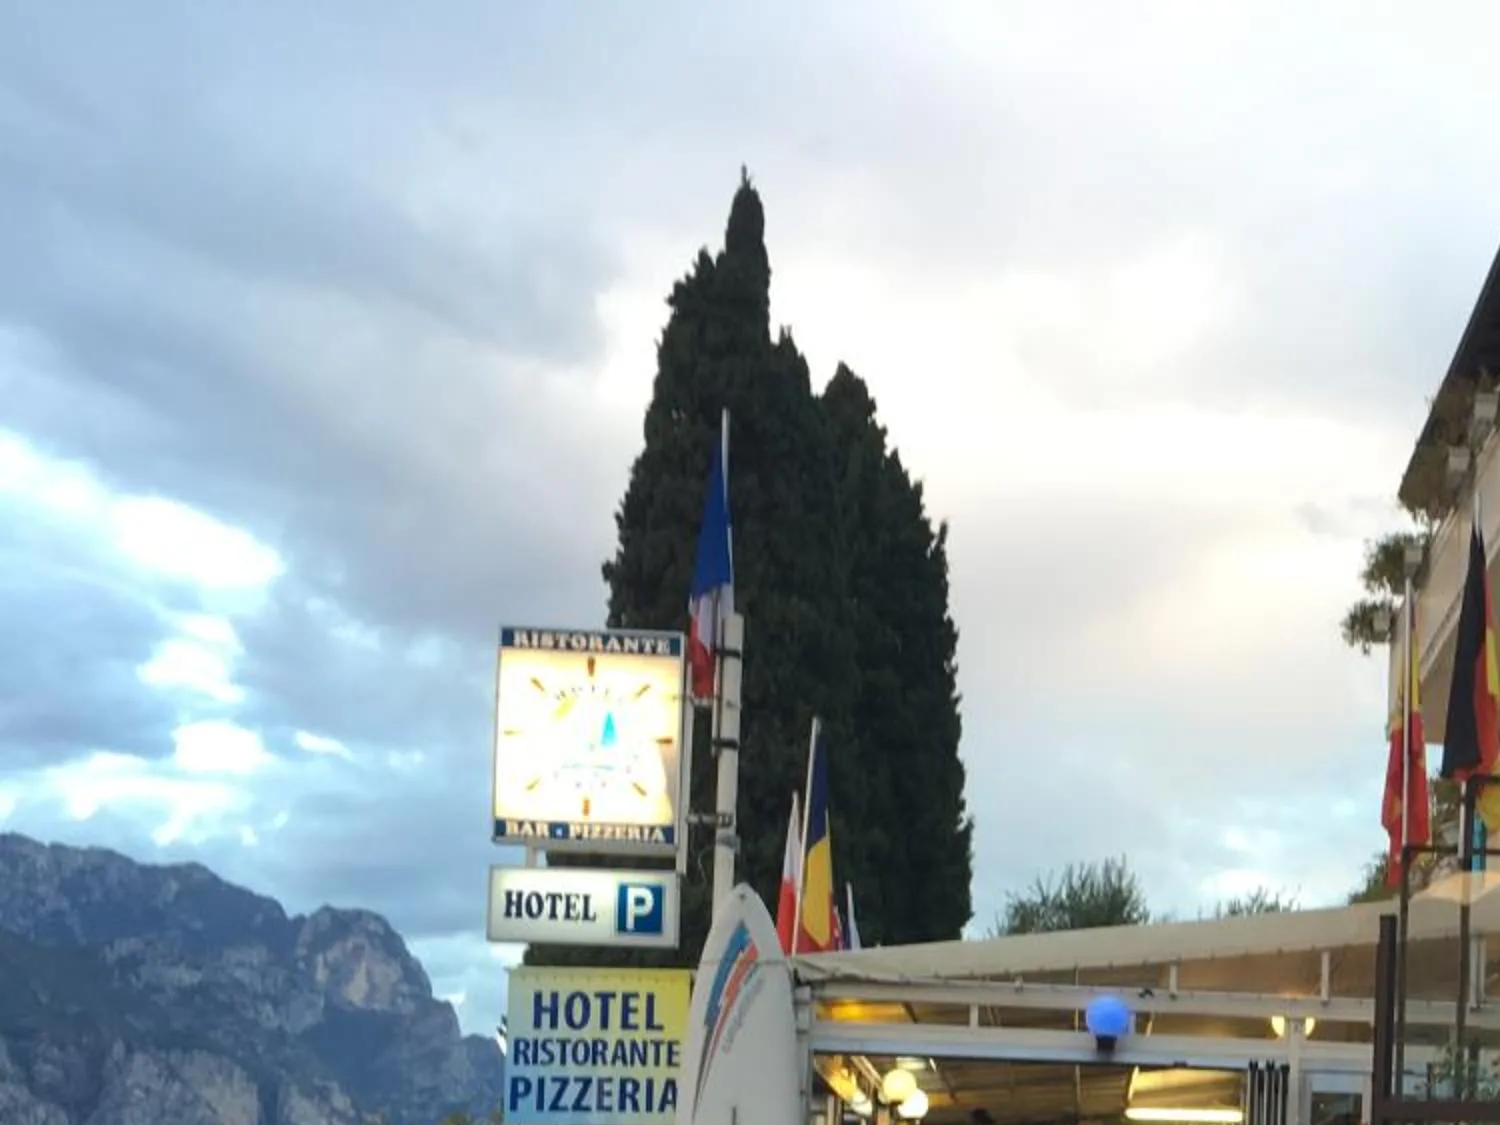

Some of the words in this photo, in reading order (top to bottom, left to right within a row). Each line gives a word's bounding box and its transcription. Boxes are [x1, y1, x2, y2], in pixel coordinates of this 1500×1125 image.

[512, 630, 671, 654] RISTORANTE
[505, 820, 549, 838] BAR
[569, 823, 665, 842] PIZZERIA
[504, 890, 597, 922] HOTEL
[627, 887, 655, 931] P
[533, 990, 665, 1030] HOTEL
[513, 1037, 681, 1068] RISTORANTE
[509, 1076, 678, 1112] PIZZERIA
